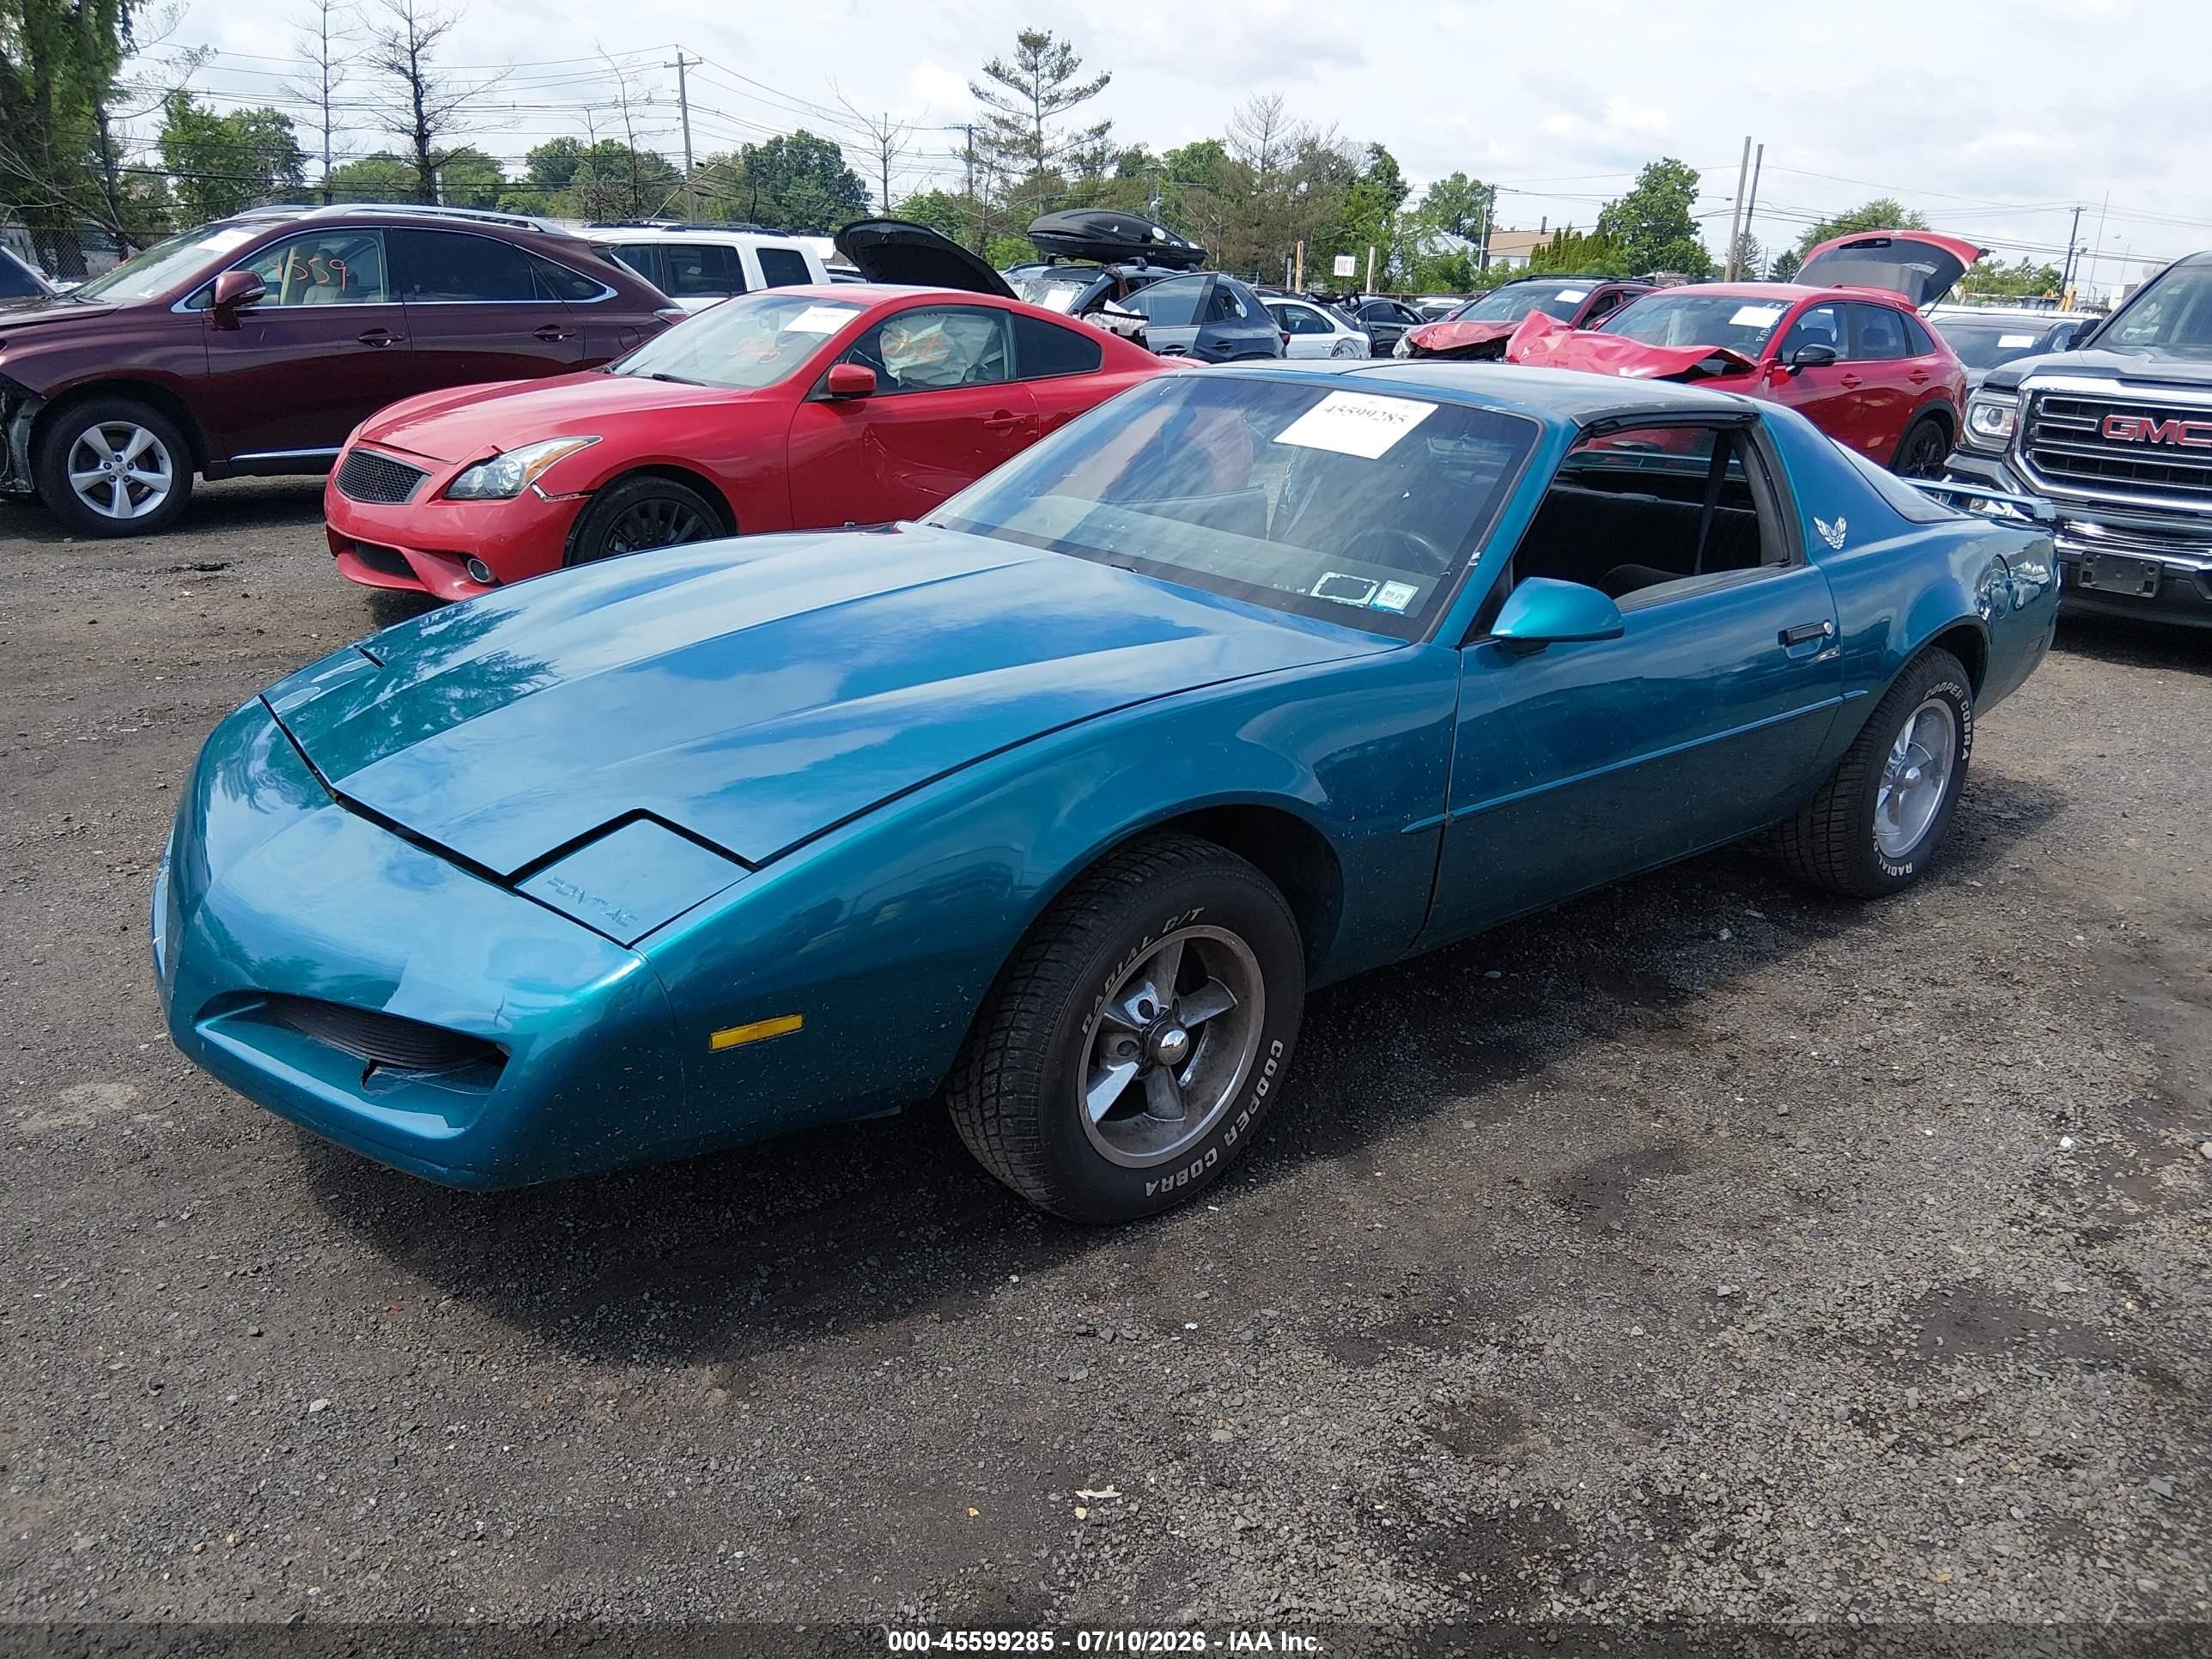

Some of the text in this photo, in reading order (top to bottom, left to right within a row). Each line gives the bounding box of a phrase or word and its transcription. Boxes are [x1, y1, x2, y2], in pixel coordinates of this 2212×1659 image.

[2102, 414, 2212, 447] GMC
[1923, 681, 1972, 761] COOPER COBRA
[1878, 852, 1912, 877] RADIAL
[545, 876, 639, 928] PONTAC
[1145, 1039, 1285, 1198] COOPER COBRA
